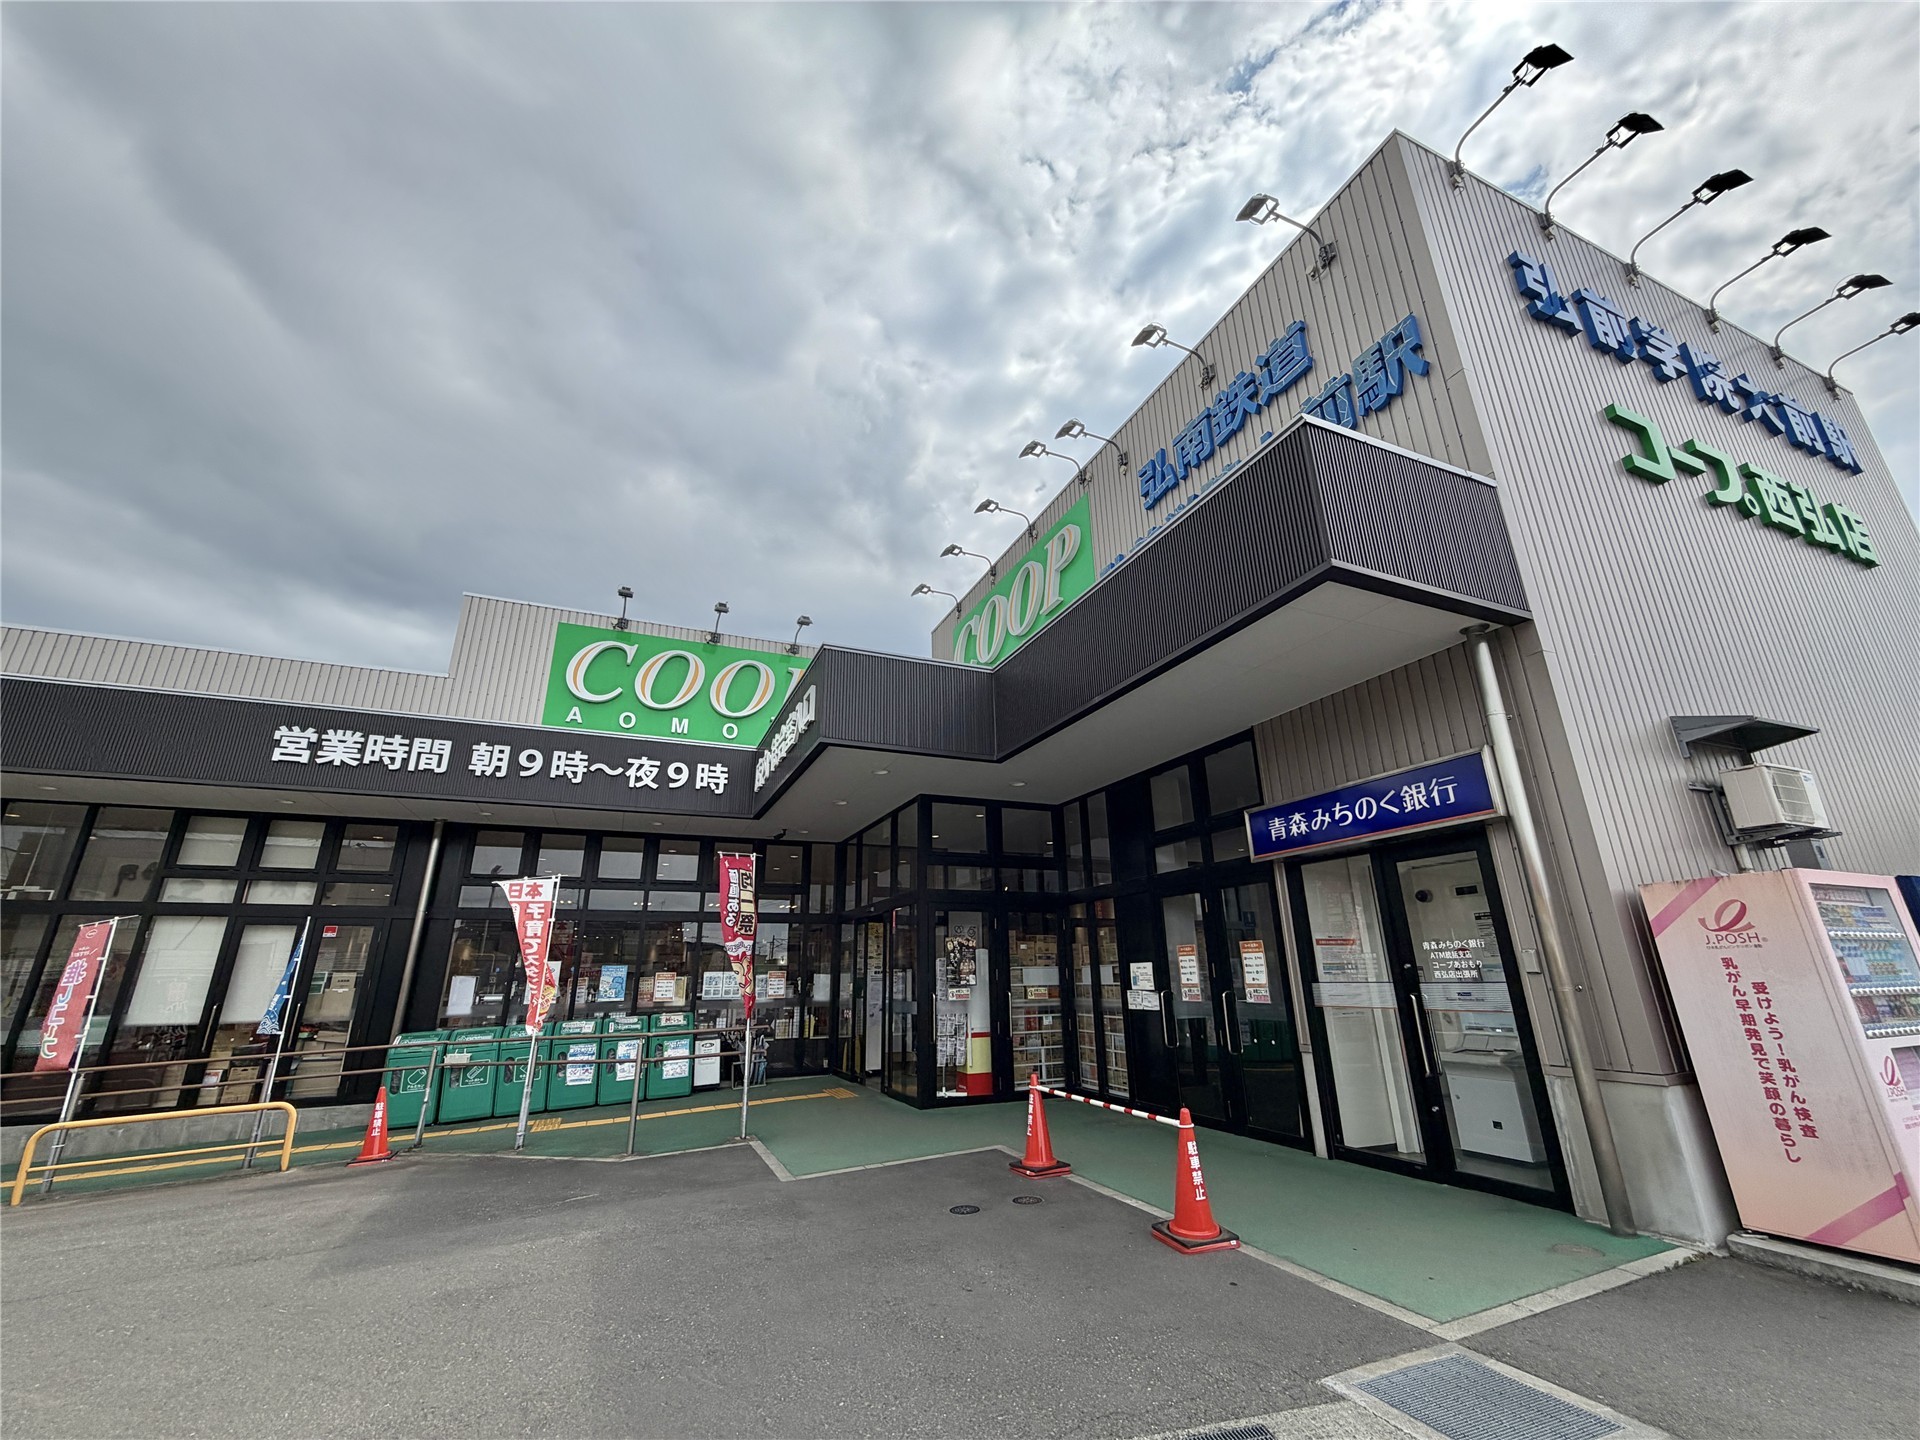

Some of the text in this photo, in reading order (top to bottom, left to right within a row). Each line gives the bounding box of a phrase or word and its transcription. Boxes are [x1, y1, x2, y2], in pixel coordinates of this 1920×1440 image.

[1508, 250, 1864, 475] 弘前学院大前駅
[1138, 320, 1313, 510] 弘南鉄道
[271, 725, 452, 774] 営業時間
[1268, 776, 1458, 842] 青森みちのく銀行
[1422, 938, 1485, 951] 青森みちのく銀行
[1432, 960, 1483, 969] コープあおもり
[1705, 931, 1761, 945] J.POSH
[1720, 956, 1801, 1163] 乳がん早期発見で笑顔の暮らし
[371, 1102, 384, 1137] 駐車禁止
[1187, 1140, 1206, 1200] 駐車禁止
